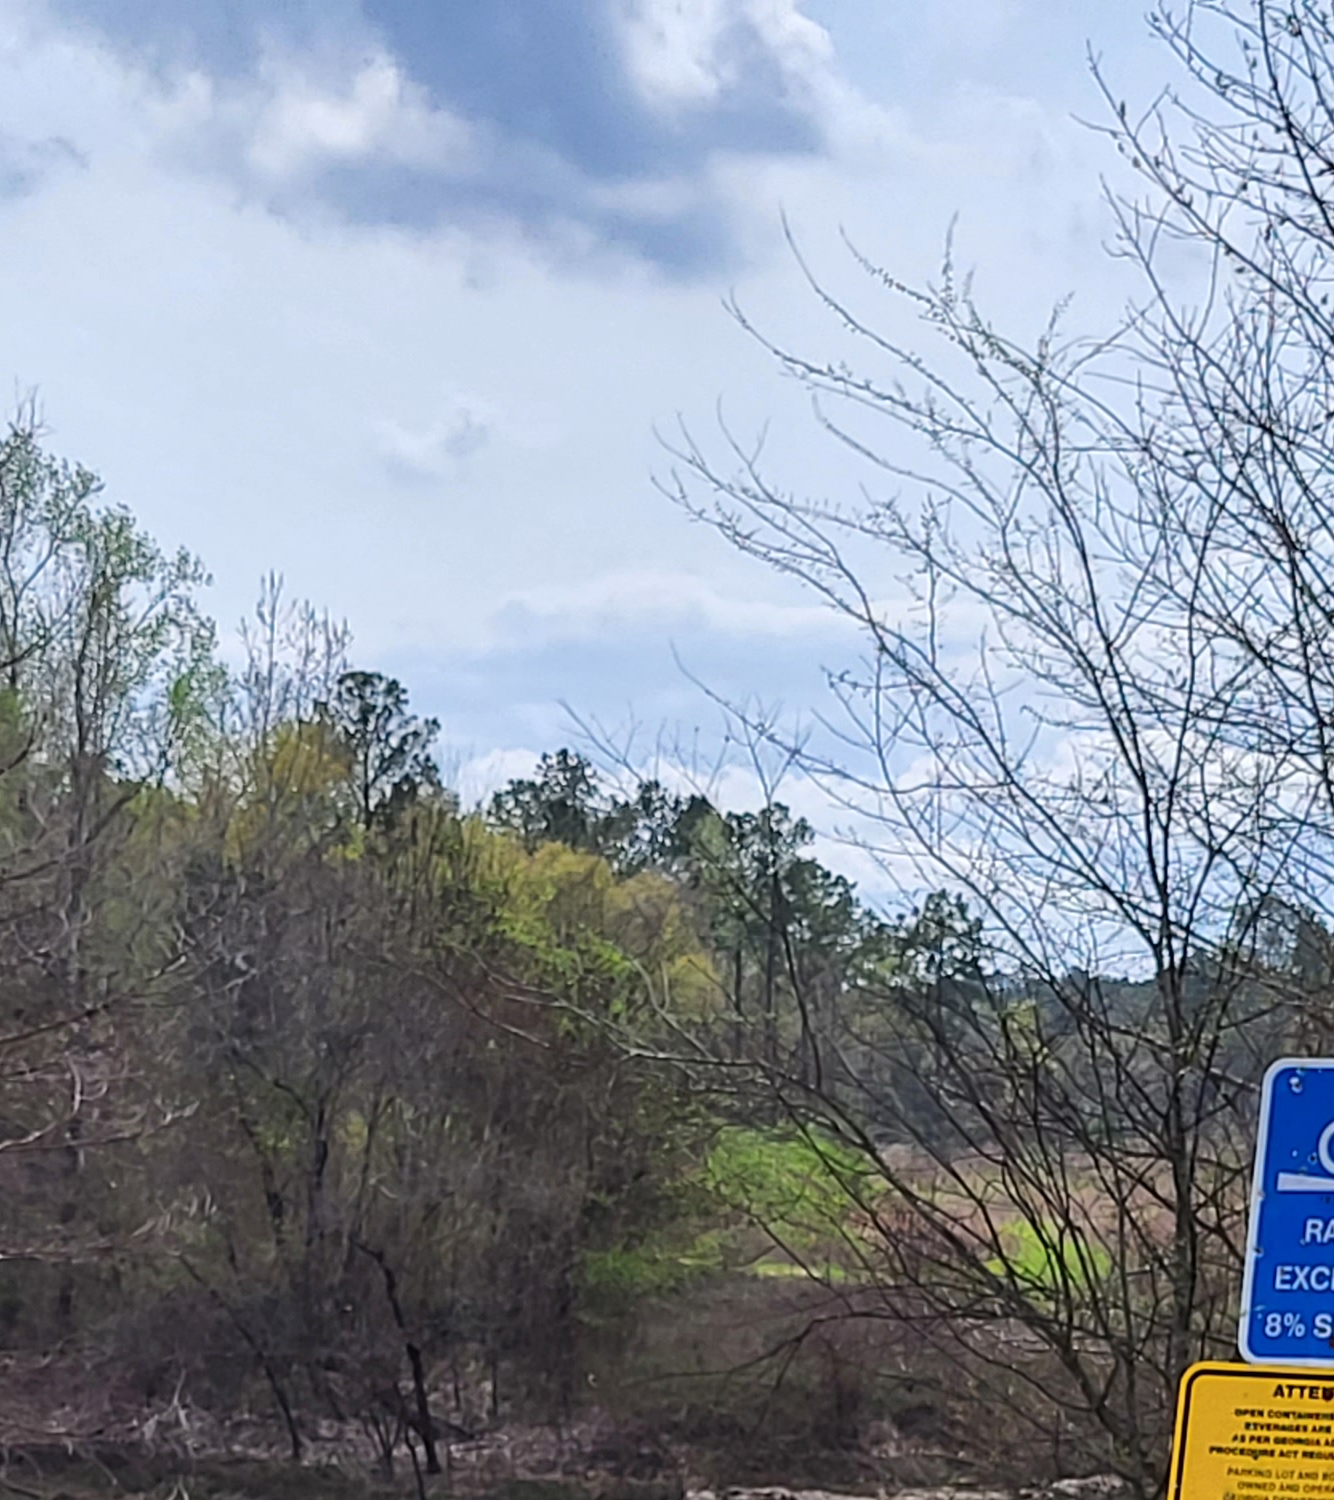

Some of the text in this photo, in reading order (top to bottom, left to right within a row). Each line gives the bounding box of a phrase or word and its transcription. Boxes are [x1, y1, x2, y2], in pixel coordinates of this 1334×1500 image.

[1264, 1312, 1306, 1338] 8%
[1275, 1469, 1295, 1480] LOT
[1237, 1481, 1276, 1492] OWNED
